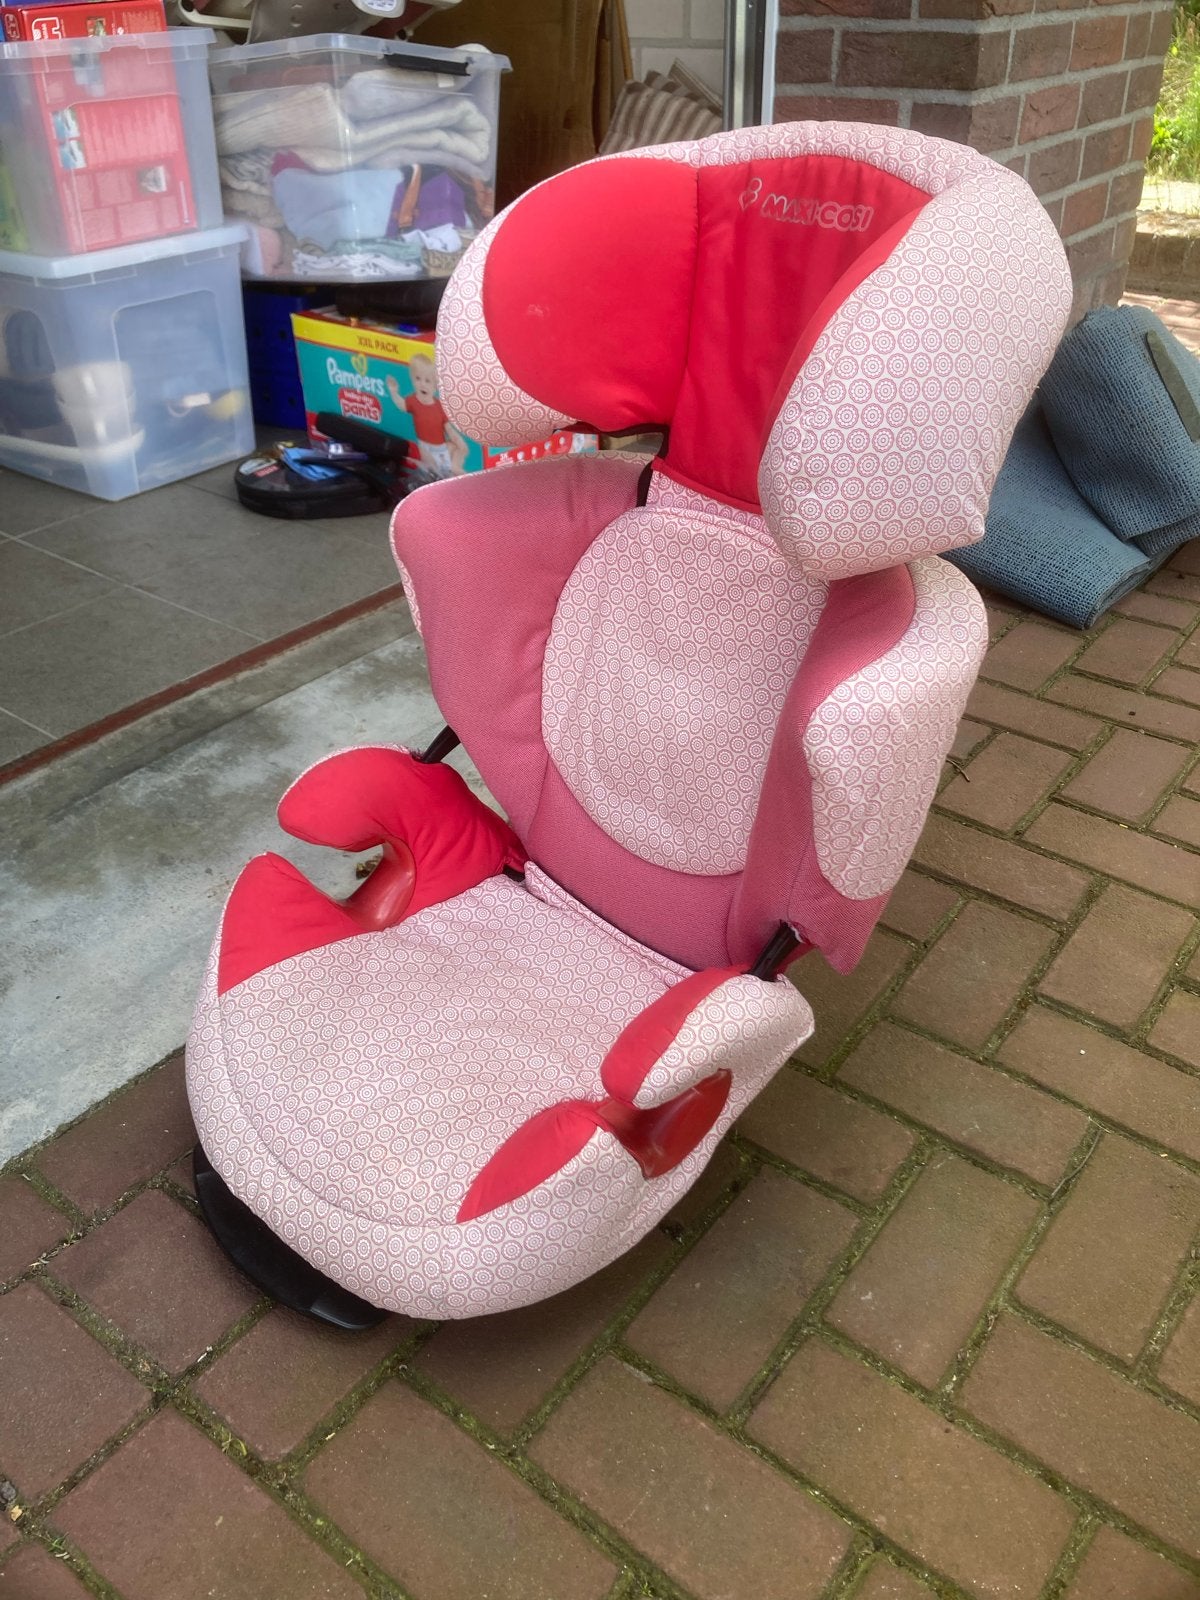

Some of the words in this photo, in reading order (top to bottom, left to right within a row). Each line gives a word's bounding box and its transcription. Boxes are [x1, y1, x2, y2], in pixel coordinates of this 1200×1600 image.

[357, 335, 374, 349] XXL
[375, 340, 399, 354] PACK
[326, 356, 385, 397] Pampers
[342, 401, 379, 422] pants
